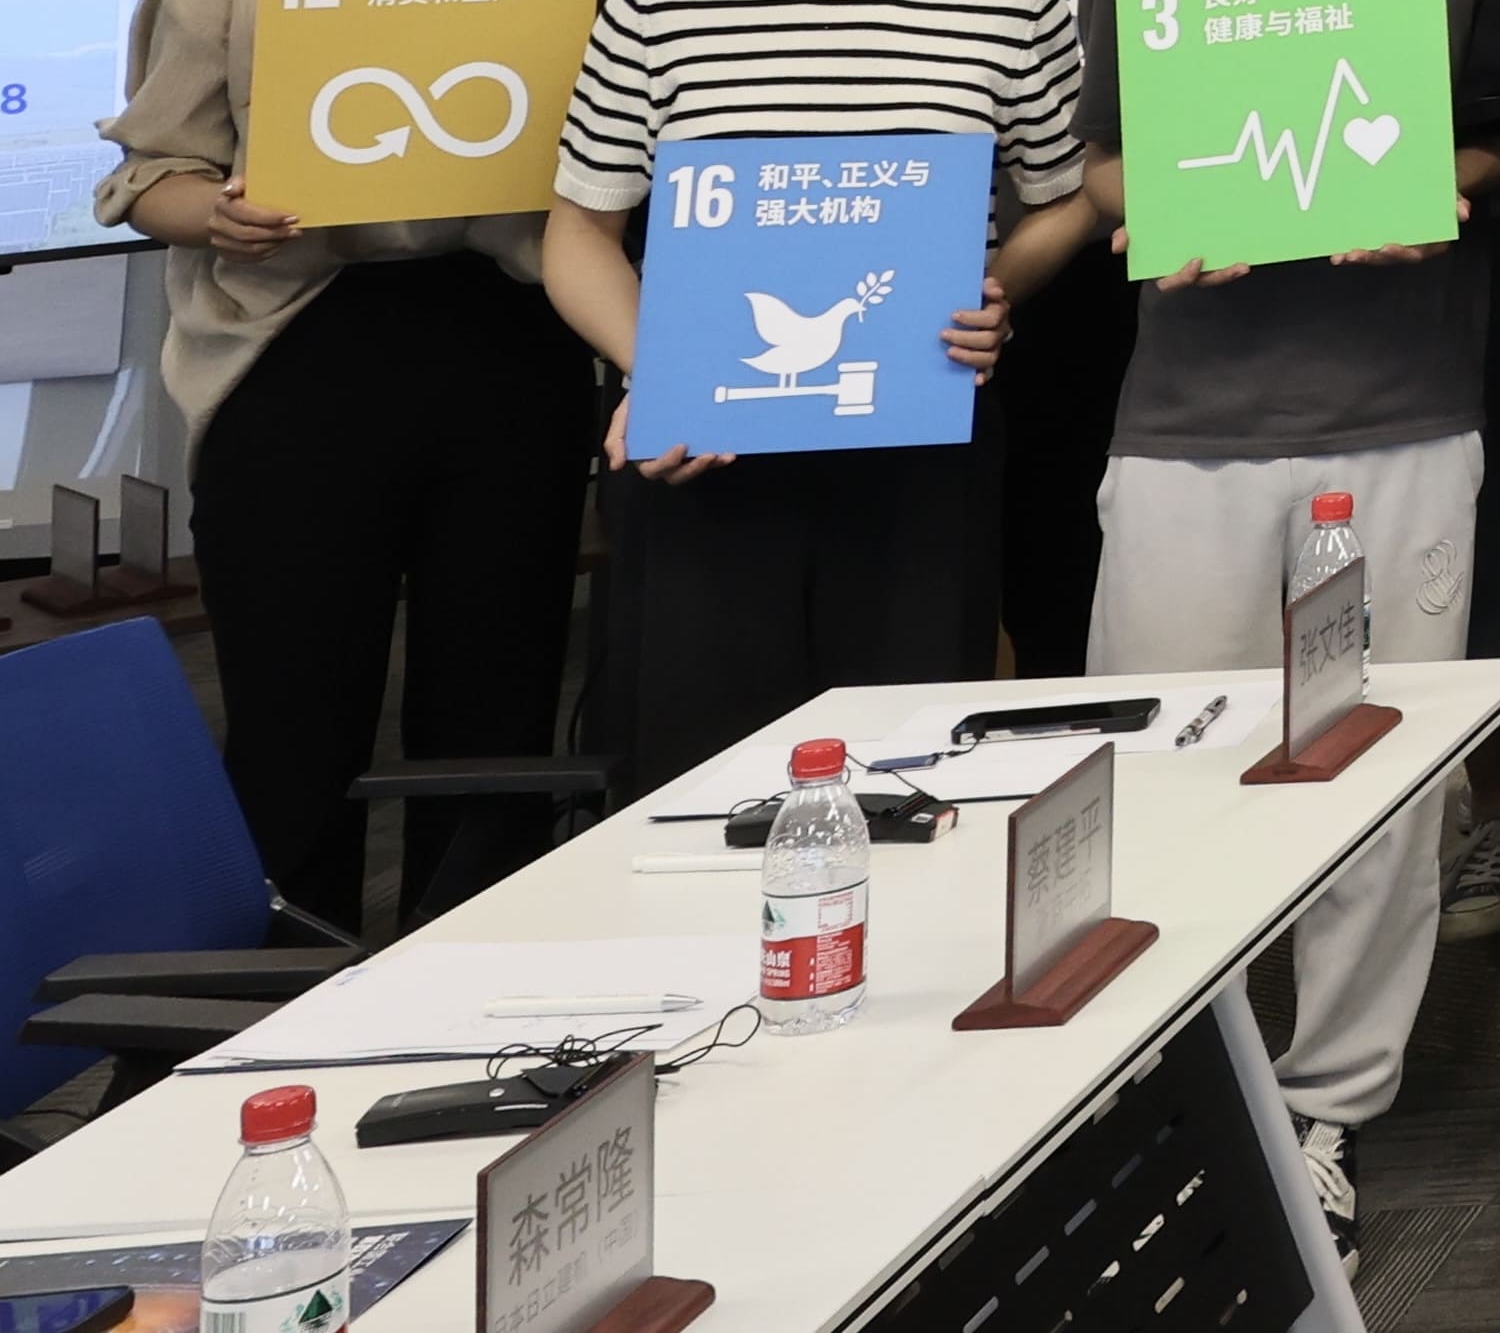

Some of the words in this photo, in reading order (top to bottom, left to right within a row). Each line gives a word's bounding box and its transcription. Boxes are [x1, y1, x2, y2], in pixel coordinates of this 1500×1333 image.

[1205, 3, 1353, 44] 健康与福祉
[669, 165, 734, 227] 16
[759, 160, 929, 190] 和平、正义与
[756, 196, 880, 226] 强大机构
[1300, 598, 1355, 686] 张文佳
[509, 1127, 635, 1286] 森常隆
